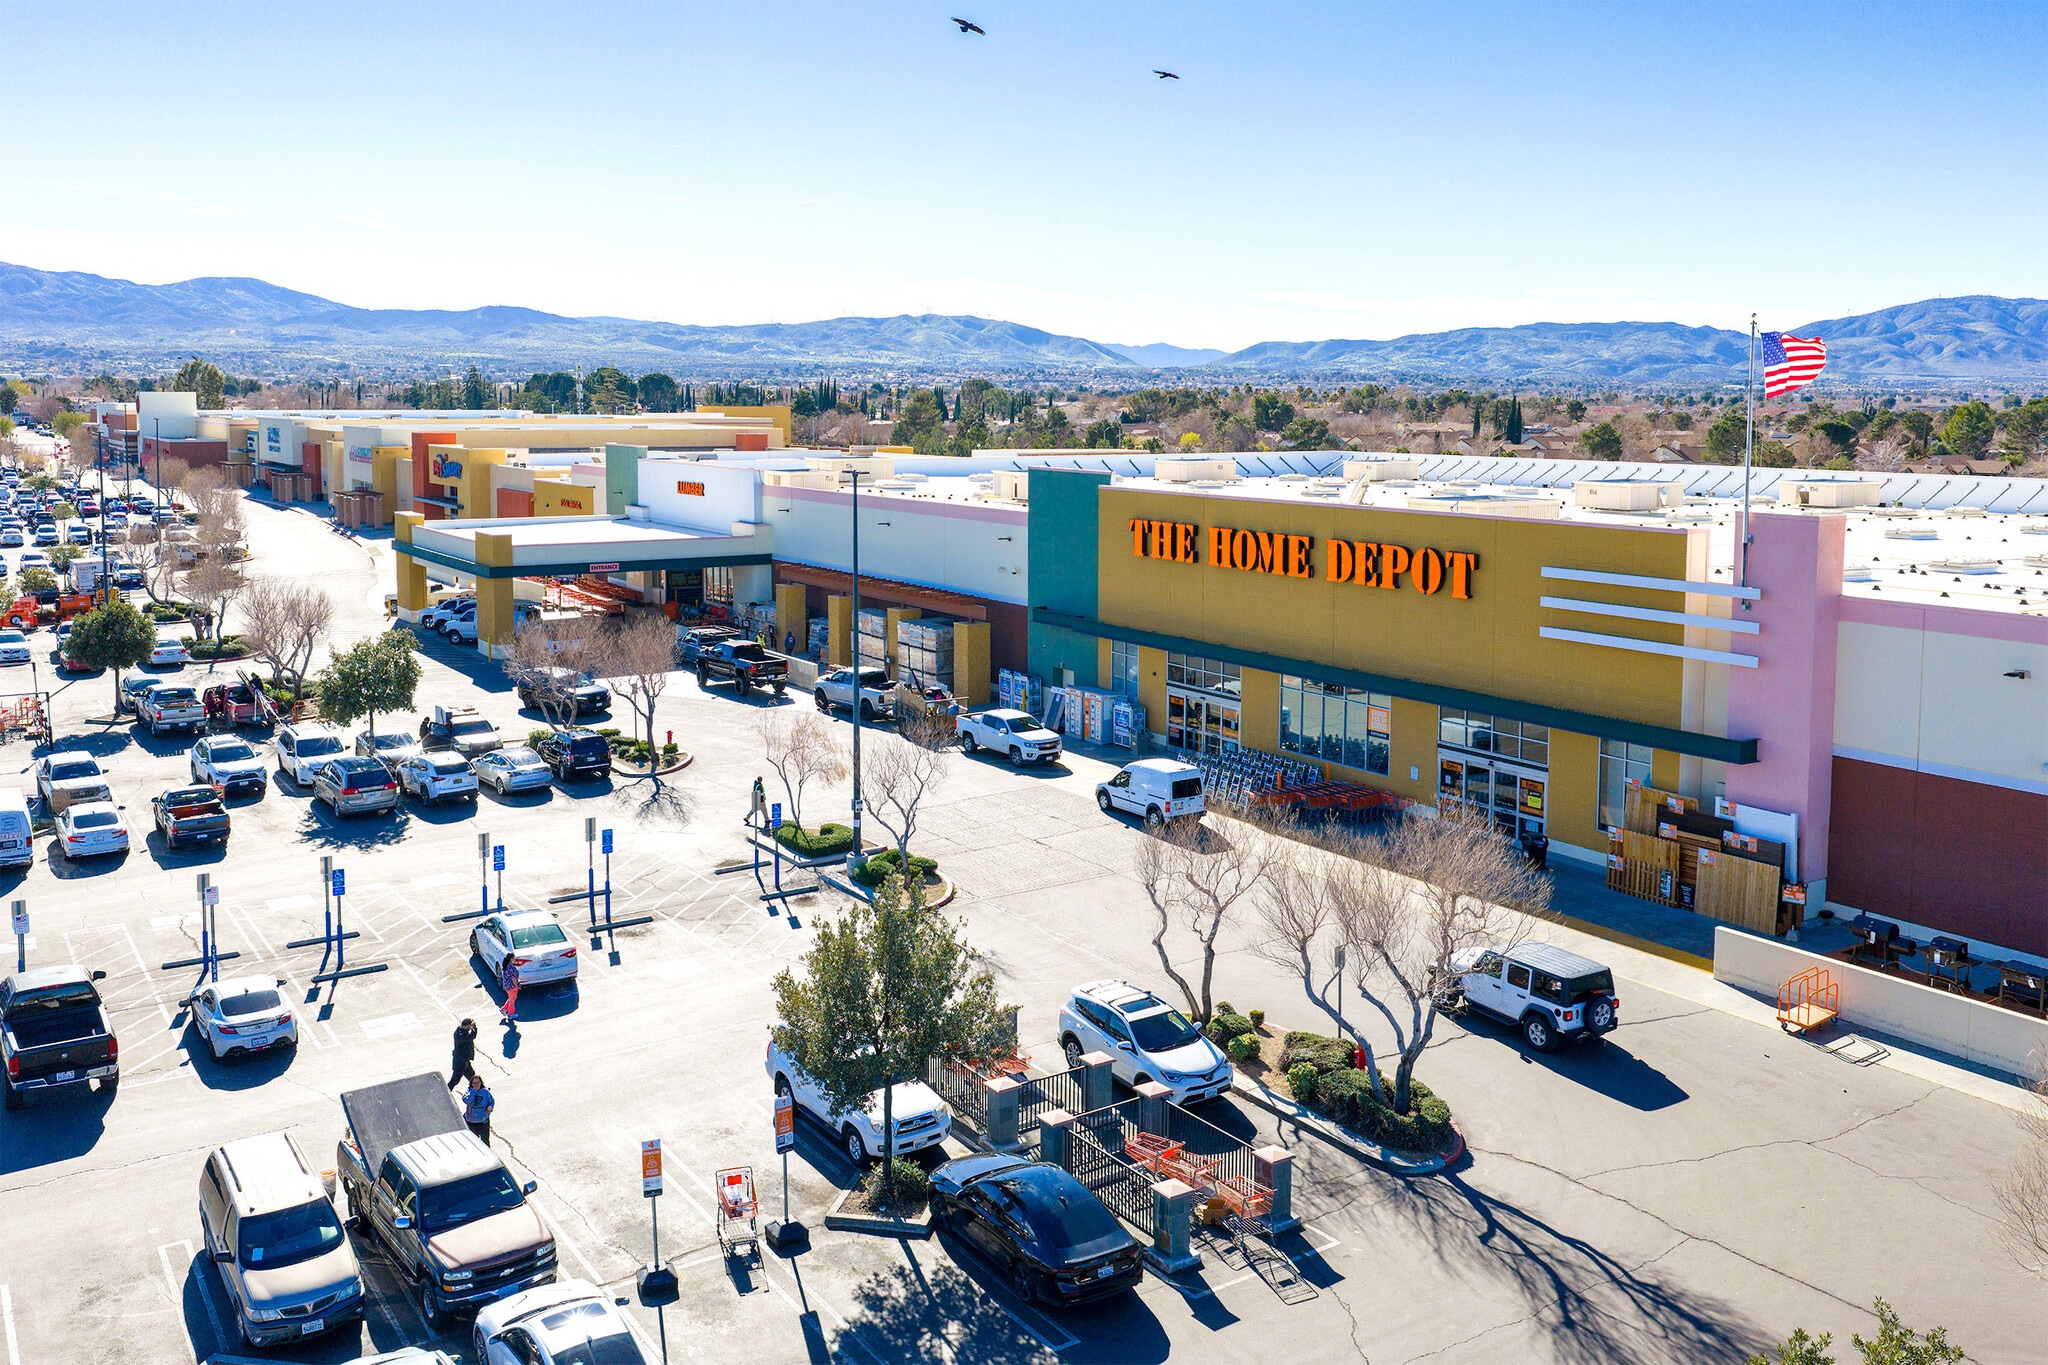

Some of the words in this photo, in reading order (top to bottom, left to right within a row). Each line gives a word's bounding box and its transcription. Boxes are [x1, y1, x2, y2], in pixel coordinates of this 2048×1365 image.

[677, 480, 705, 496] LUMBER
[1129, 518, 1198, 563] THE
[1207, 526, 1314, 579] HOME
[1325, 538, 1480, 600] DEPOT
[647, 1140, 654, 1149] 4
